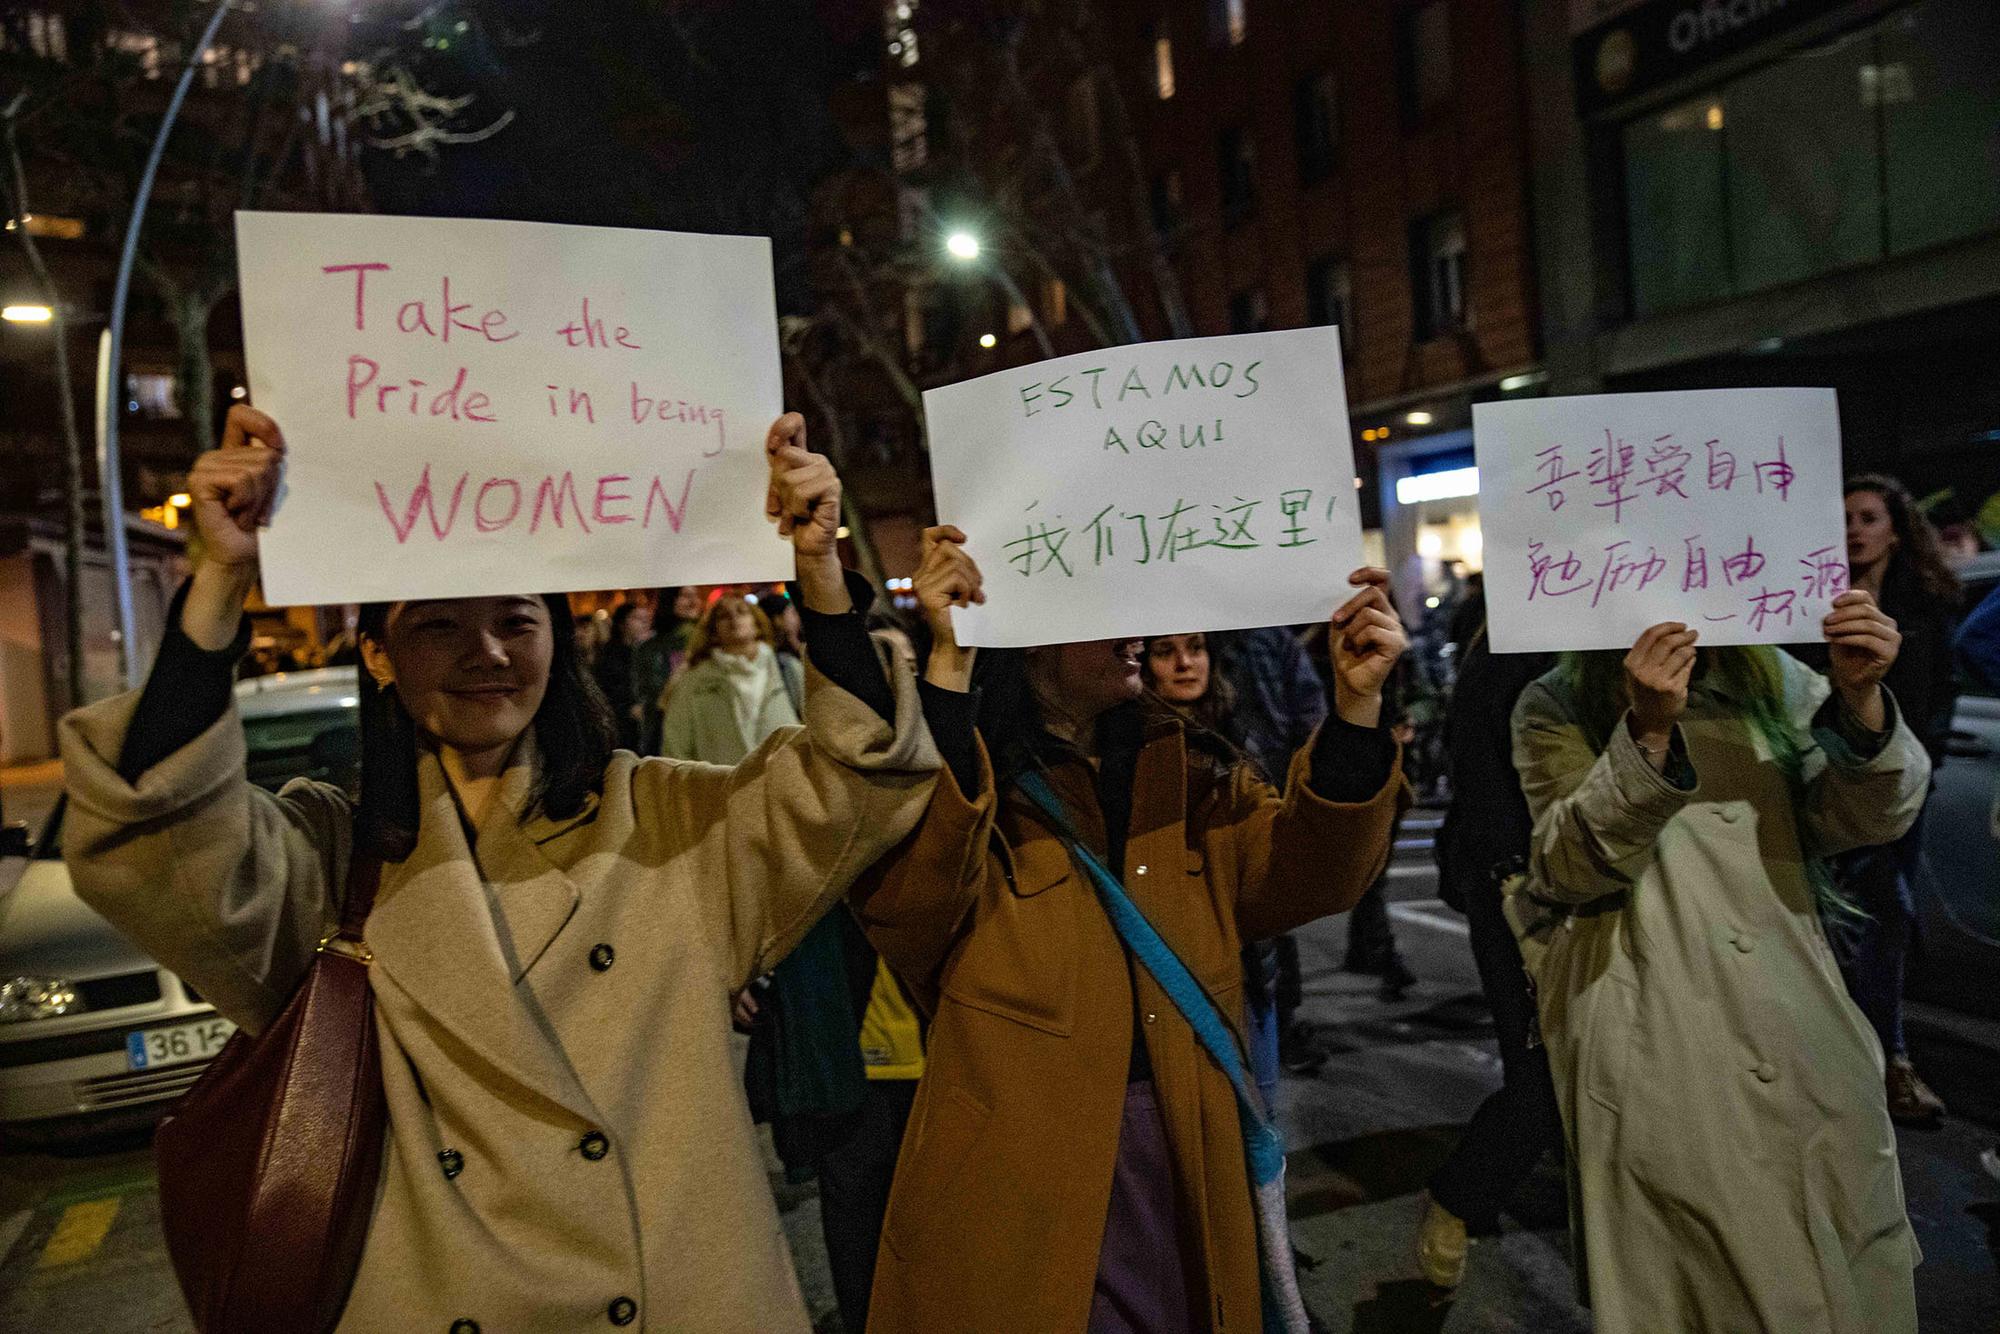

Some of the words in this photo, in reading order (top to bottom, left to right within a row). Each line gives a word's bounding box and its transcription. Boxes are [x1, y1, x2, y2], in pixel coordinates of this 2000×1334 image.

[322, 262, 518, 343] Take
[557, 298, 641, 350] the
[346, 354, 498, 423] Pride
[545, 383, 595, 424] in
[630, 381, 726, 458] being
[1020, 360, 1262, 417] ESTAMOS
[1103, 417, 1225, 454] AQUI
[373, 462, 697, 544] WOMEN
